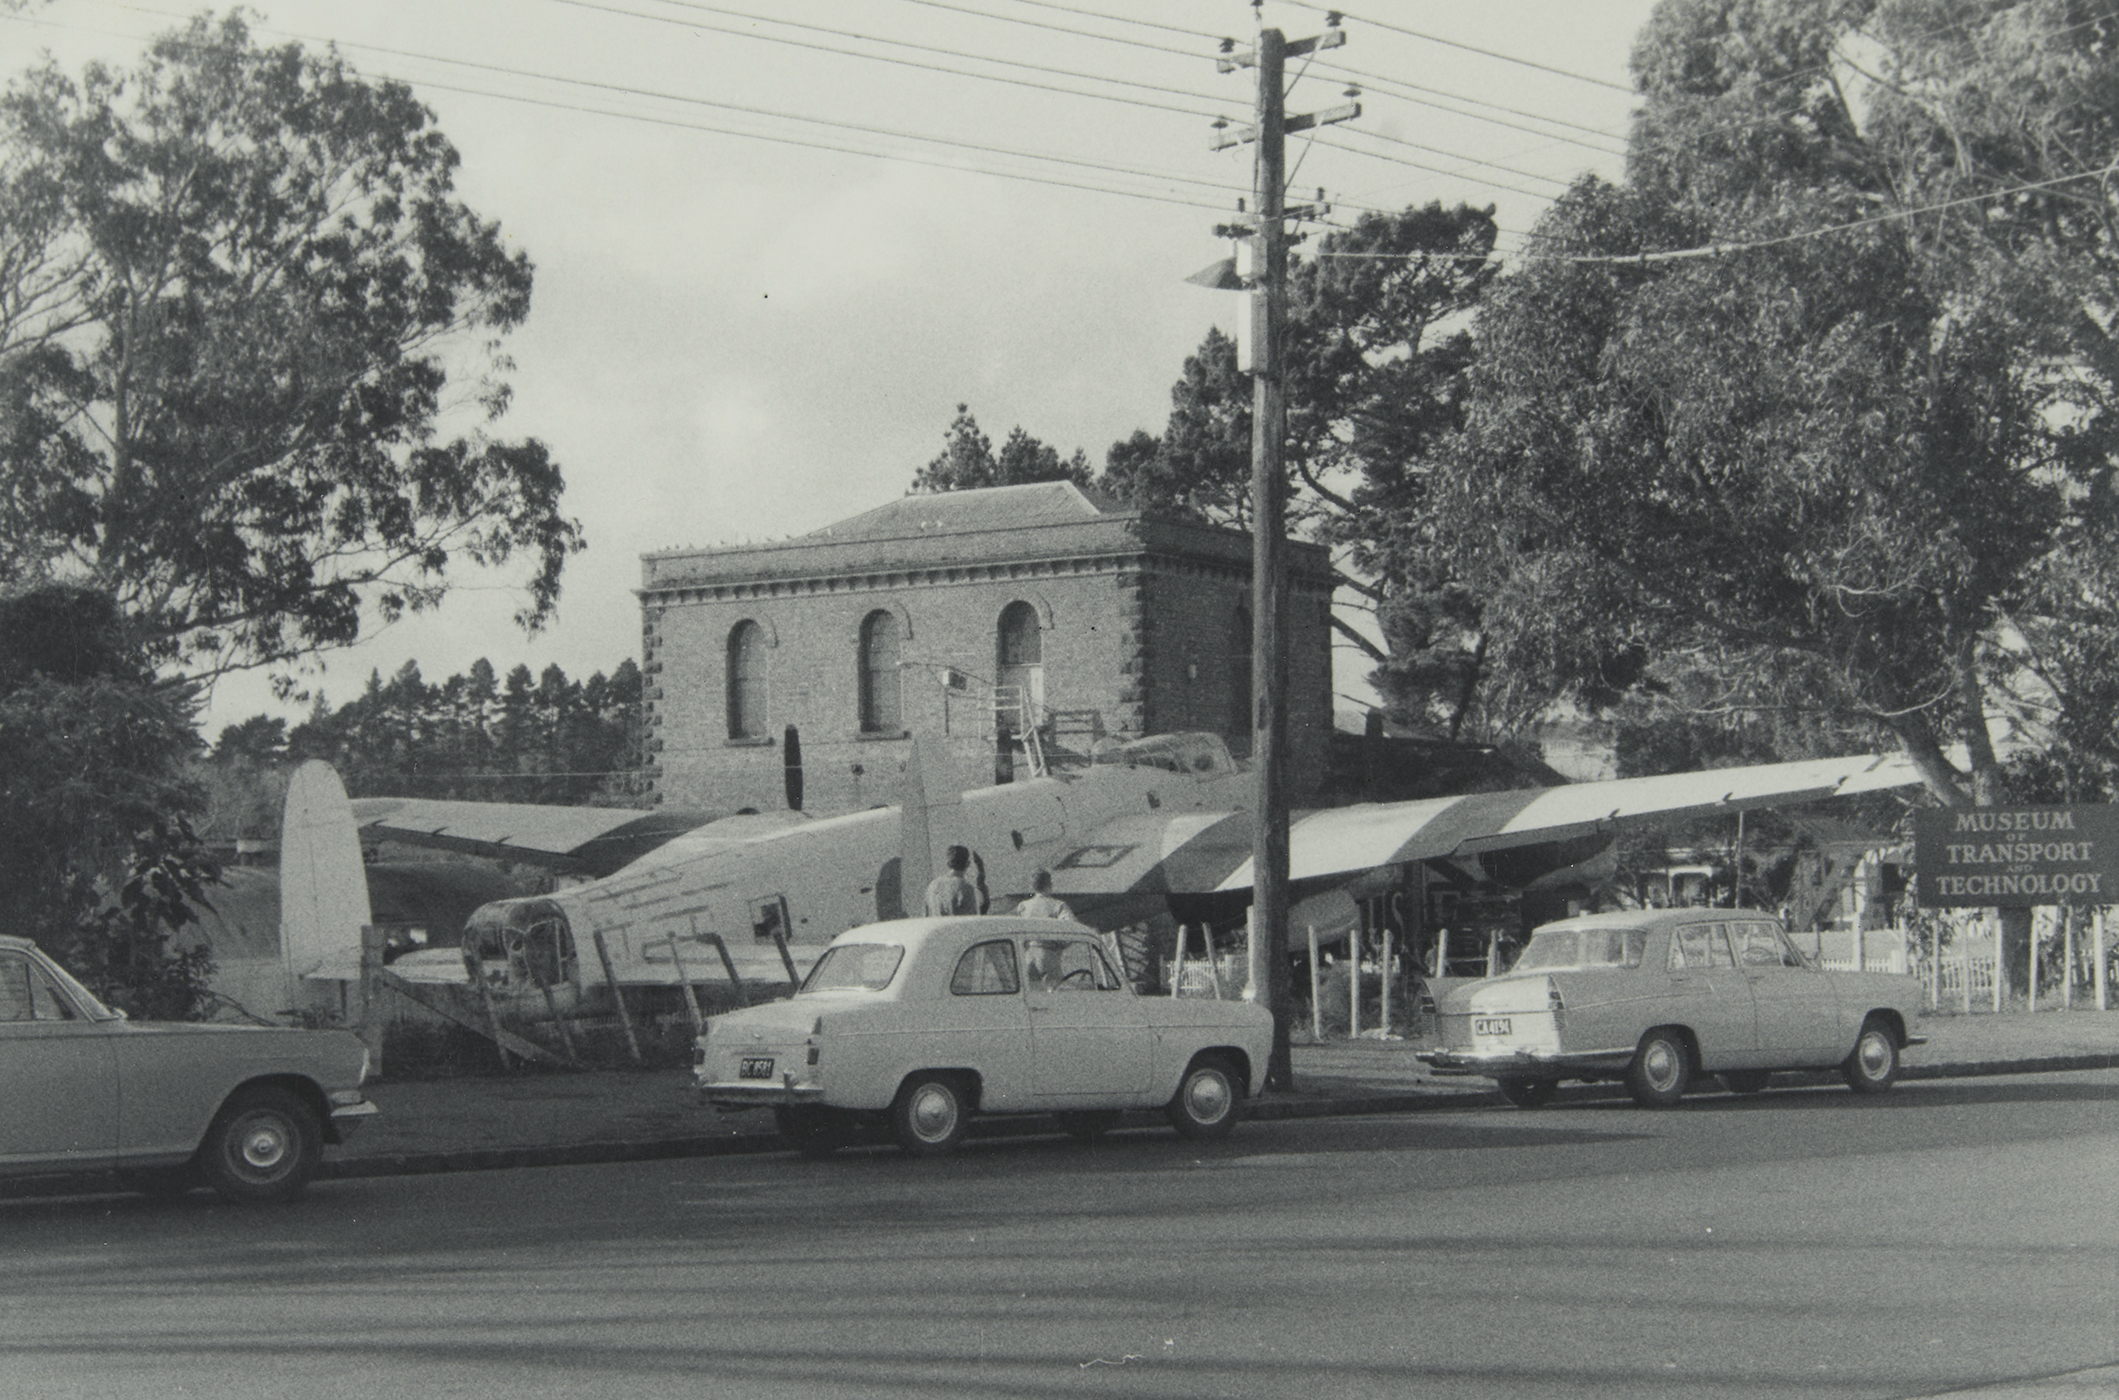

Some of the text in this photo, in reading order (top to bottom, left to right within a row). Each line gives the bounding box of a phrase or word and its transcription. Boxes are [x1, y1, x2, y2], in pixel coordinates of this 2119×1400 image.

[1955, 811, 2075, 832] MUSEUM
[2006, 833, 2028, 841] OF
[1947, 842, 2093, 863] TRANSPORT
[2006, 864, 2033, 873] AND
[1936, 873, 2102, 895] TECHNOLOGY
